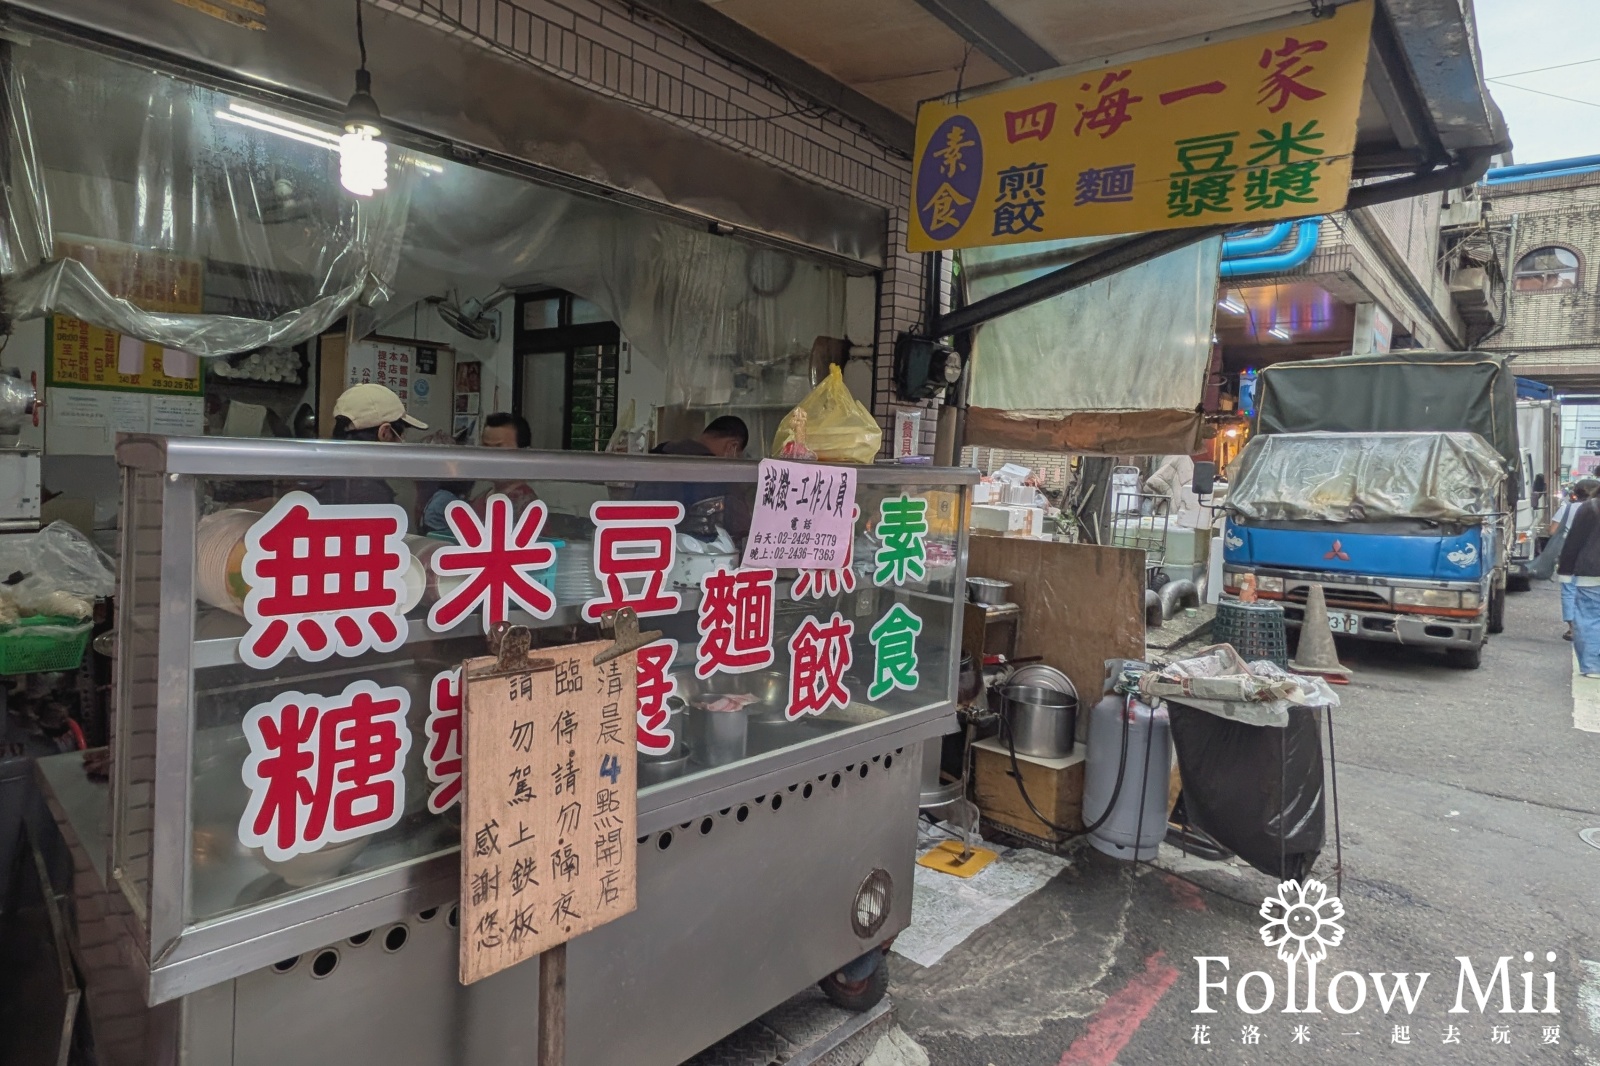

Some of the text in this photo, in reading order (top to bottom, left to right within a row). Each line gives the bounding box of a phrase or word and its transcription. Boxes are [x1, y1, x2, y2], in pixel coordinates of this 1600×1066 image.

[1004, 36, 1328, 145] 四海一家
[922, 125, 976, 232] 素食
[992, 162, 1049, 237] 煎餃
[1074, 163, 1135, 207] 麵
[1166, 131, 1241, 219] 豆漿
[1243, 119, 1325, 212] 米漿
[57, 318, 78, 331] 上午
[57, 357, 78, 370] 下午
[62, 343, 72, 355] 至
[388, 352, 398, 392] 本店不
[790, 517, 812, 531] 電話
[698, 569, 775, 676] 麵
[868, 495, 927, 698] 素食
[252, 504, 401, 851] 無糖
[472, 821, 504, 952] 感謝您
